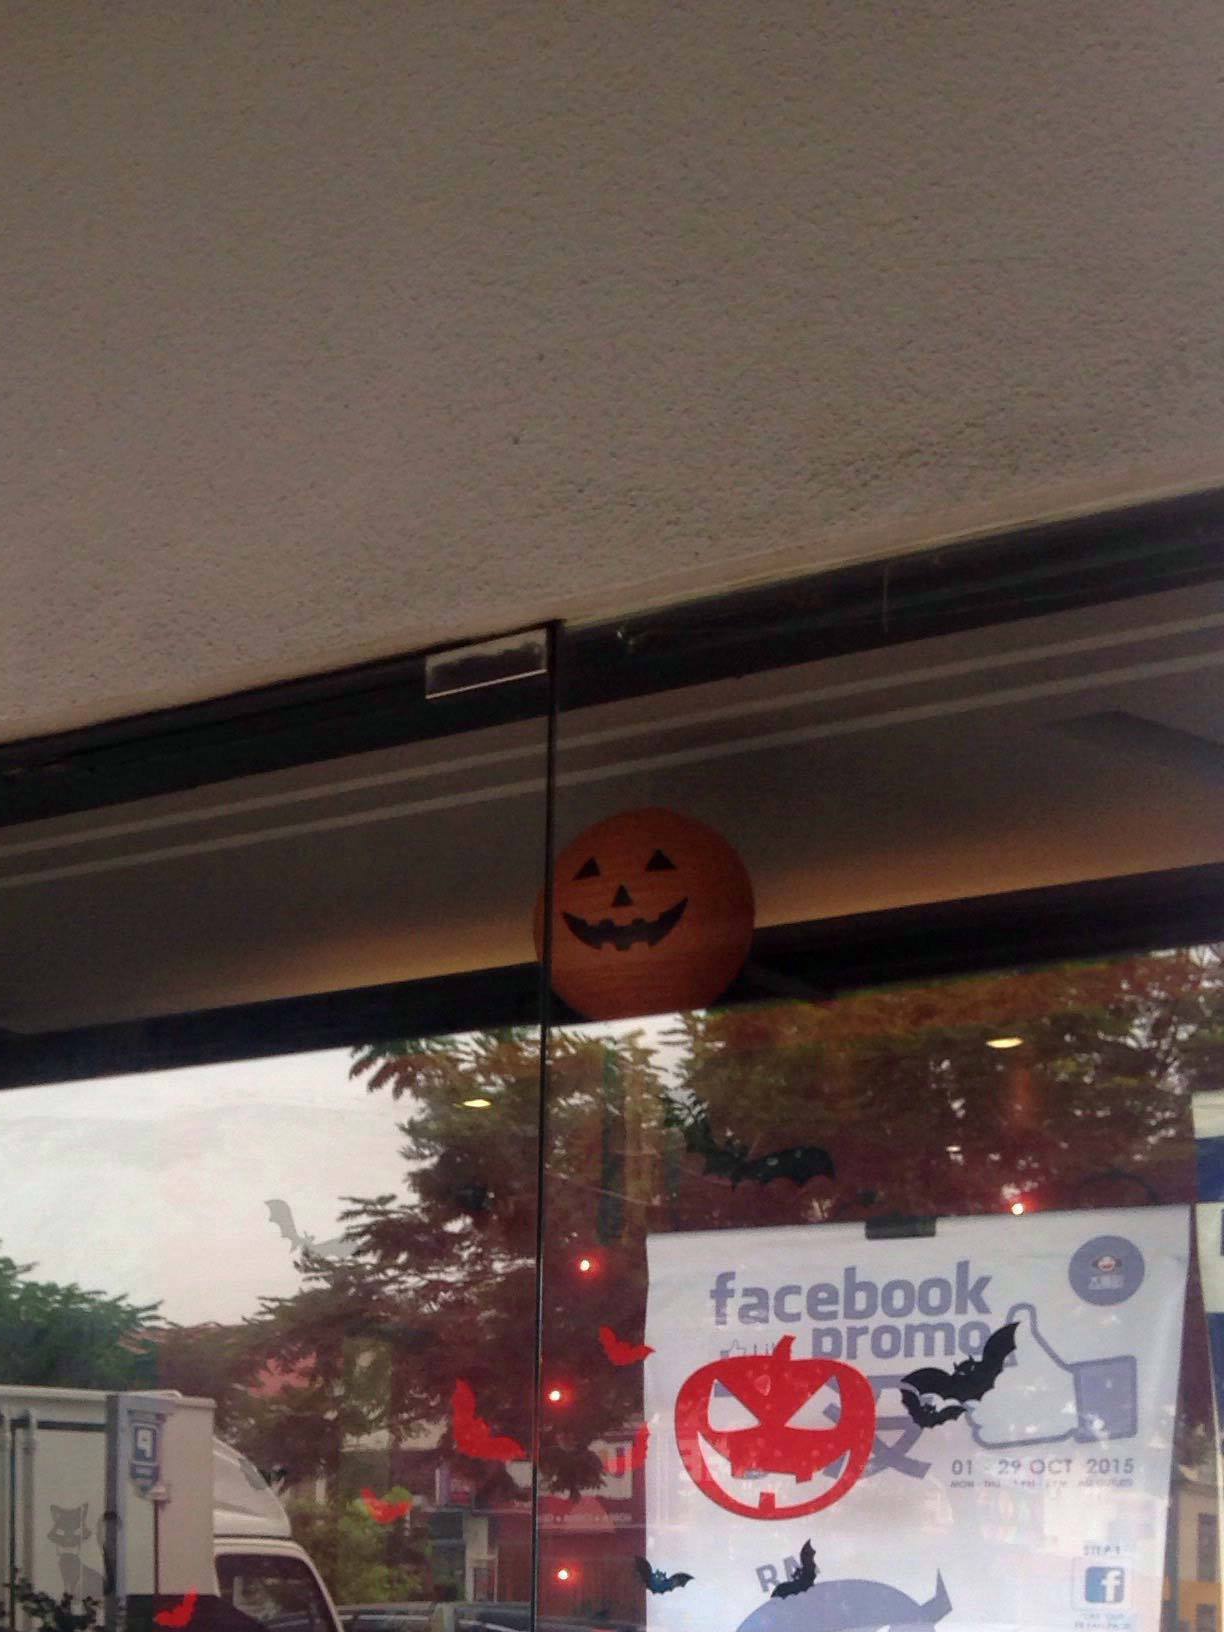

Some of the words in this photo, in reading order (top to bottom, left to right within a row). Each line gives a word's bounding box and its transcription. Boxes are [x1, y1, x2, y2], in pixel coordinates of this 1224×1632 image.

[709, 1260, 993, 1327] facebook
[812, 1320, 993, 1361] promo
[951, 1459, 974, 1476] 01
[998, 1459, 1022, 1475] 29
[1029, 1458, 1074, 1475] OCT
[1086, 1457, 1135, 1475] 2015
